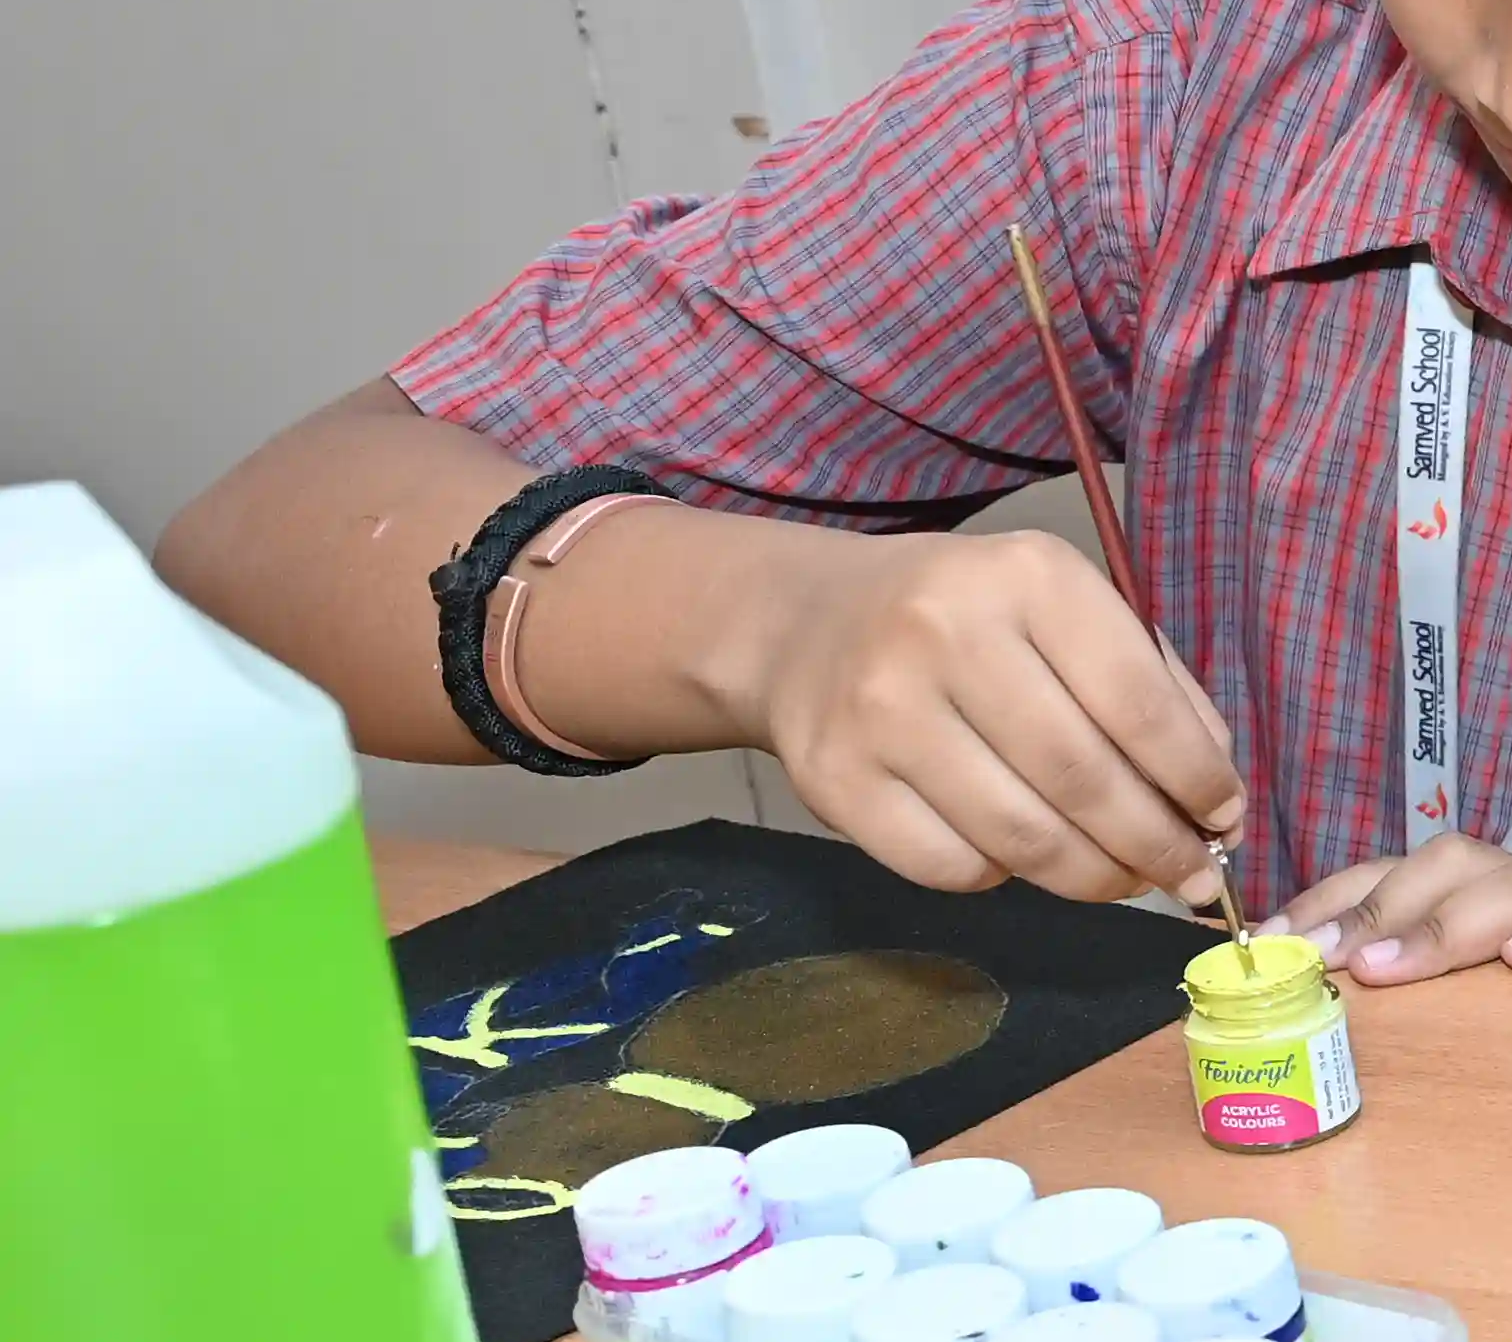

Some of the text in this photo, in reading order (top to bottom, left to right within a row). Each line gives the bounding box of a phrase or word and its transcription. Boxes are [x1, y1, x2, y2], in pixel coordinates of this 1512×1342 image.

[1405, 327, 1441, 480] Samved School
[1410, 621, 1434, 764] Samved School
[1199, 1054, 1296, 1088] Fevicryl
[1221, 1116, 1286, 1129] COLOURS
[1222, 1104, 1281, 1116] ACRYLIC
